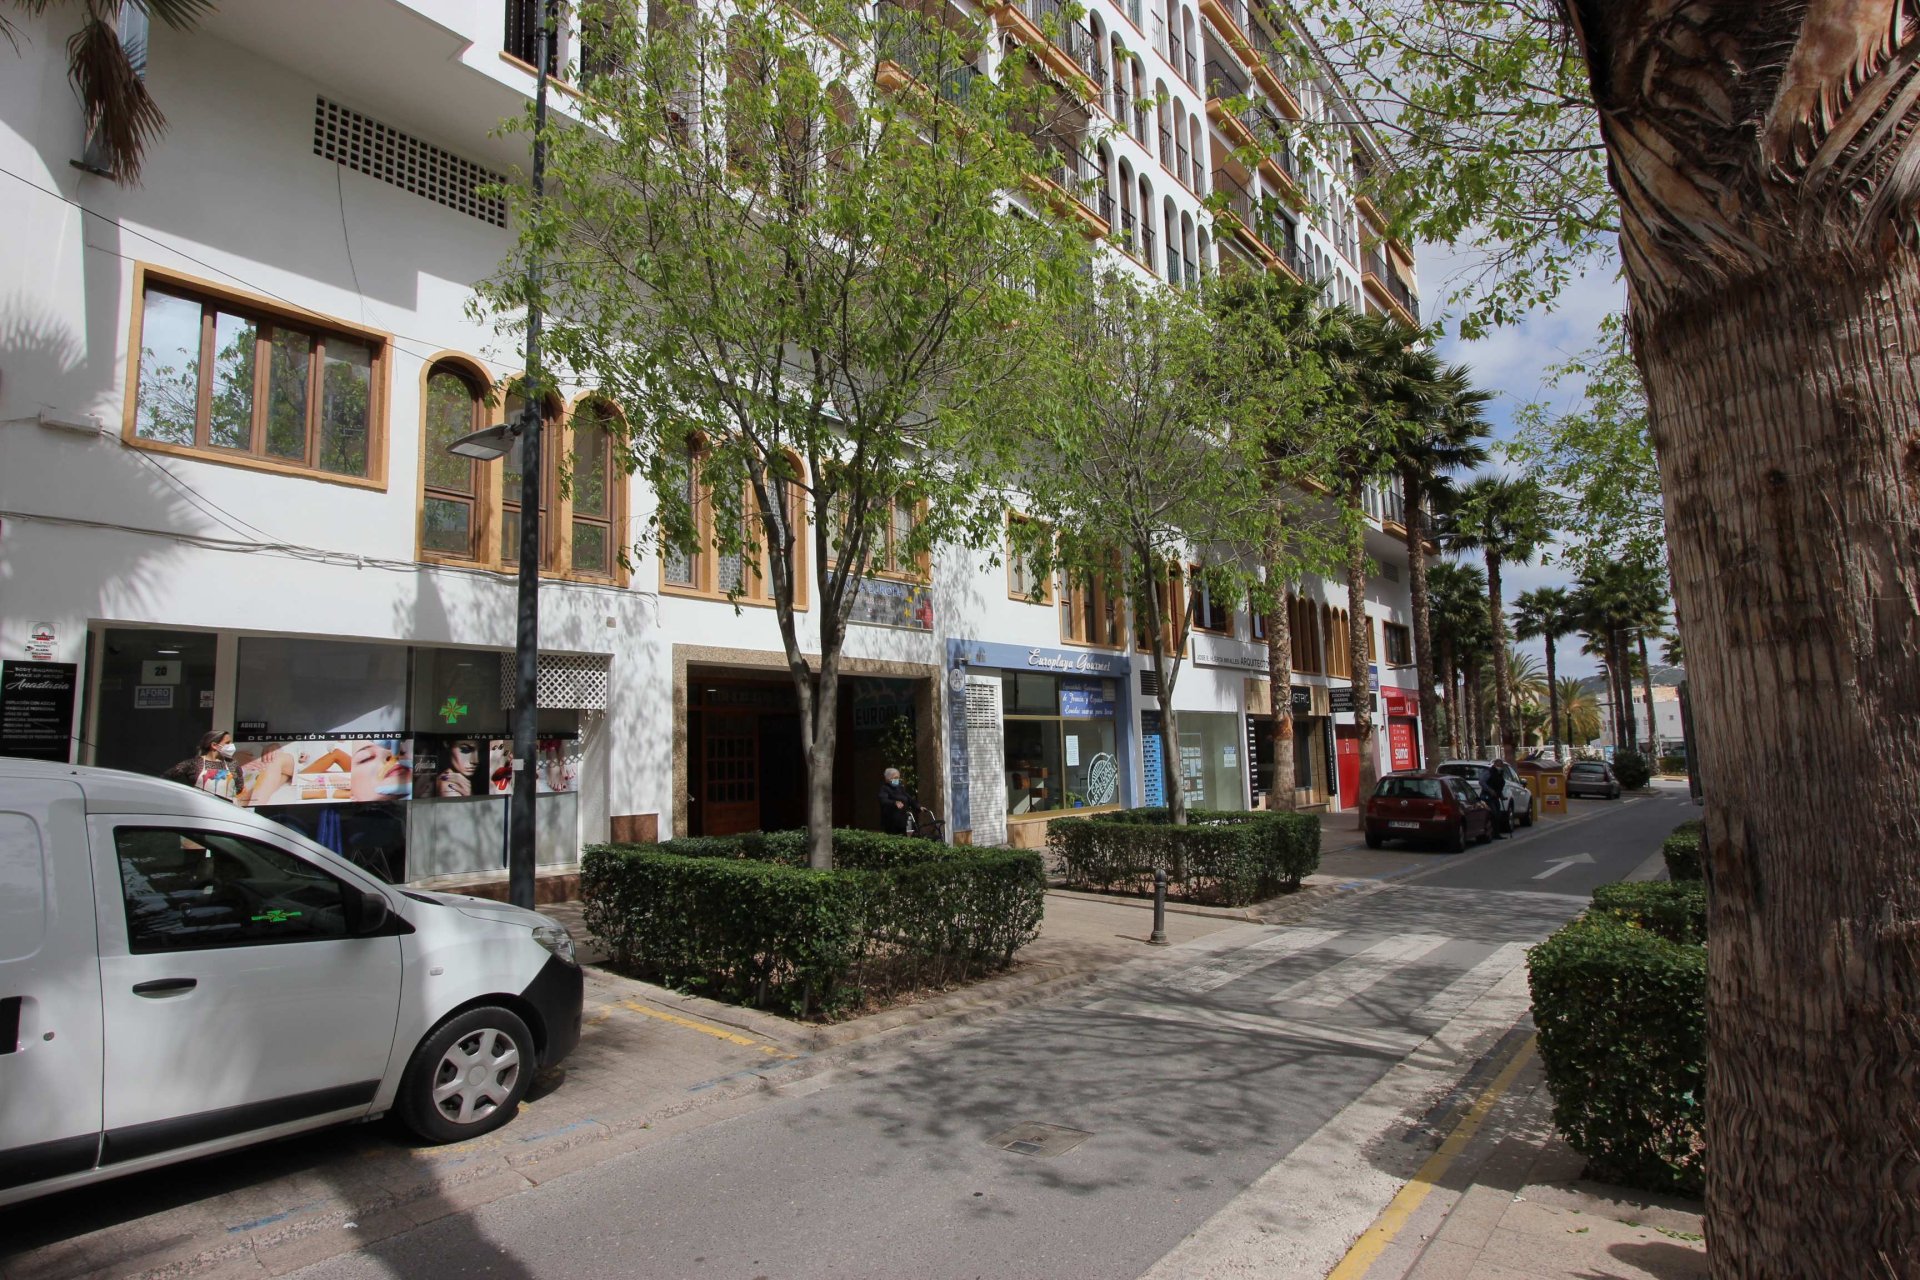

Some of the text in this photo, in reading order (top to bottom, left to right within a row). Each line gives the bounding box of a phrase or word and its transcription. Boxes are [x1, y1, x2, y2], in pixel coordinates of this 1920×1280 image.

[1028, 648, 1111, 672] Europlaya Gourmet
[5, 679, 70, 690] Anastasia
[139, 688, 169, 698] AFORO
[247, 732, 326, 741] DEPILACIÓN
[1091, 761, 1112, 795] CALIDAD
